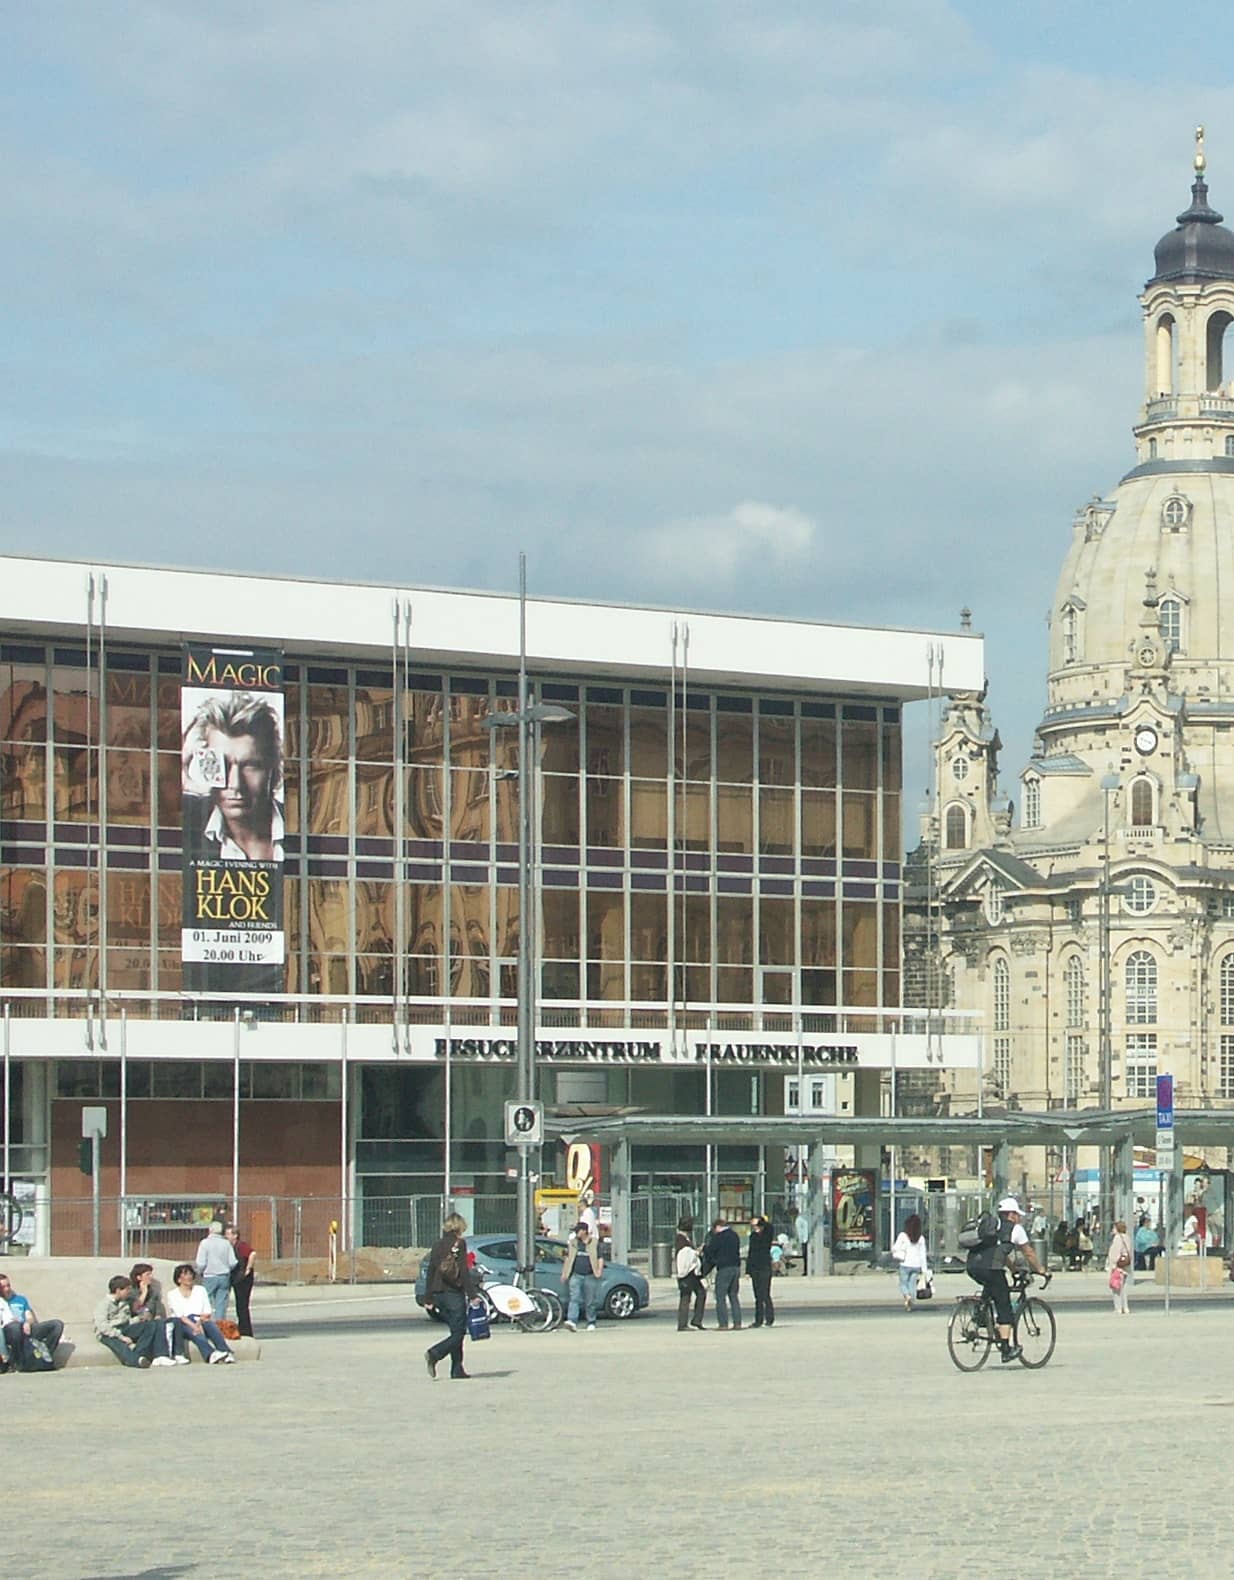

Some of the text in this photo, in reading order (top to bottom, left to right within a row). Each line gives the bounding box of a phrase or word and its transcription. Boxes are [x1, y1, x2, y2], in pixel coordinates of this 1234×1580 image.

[186, 655, 280, 688] MAGIC
[196, 869, 270, 896] HANS
[196, 895, 269, 920] KLOK
[228, 921, 278, 929] AND FRIENDS
[193, 931, 273, 944] 01. Juni 2009
[203, 949, 264, 961] 20.00 Uhr
[695, 1042, 859, 1063] FRAUENKIRCHE
